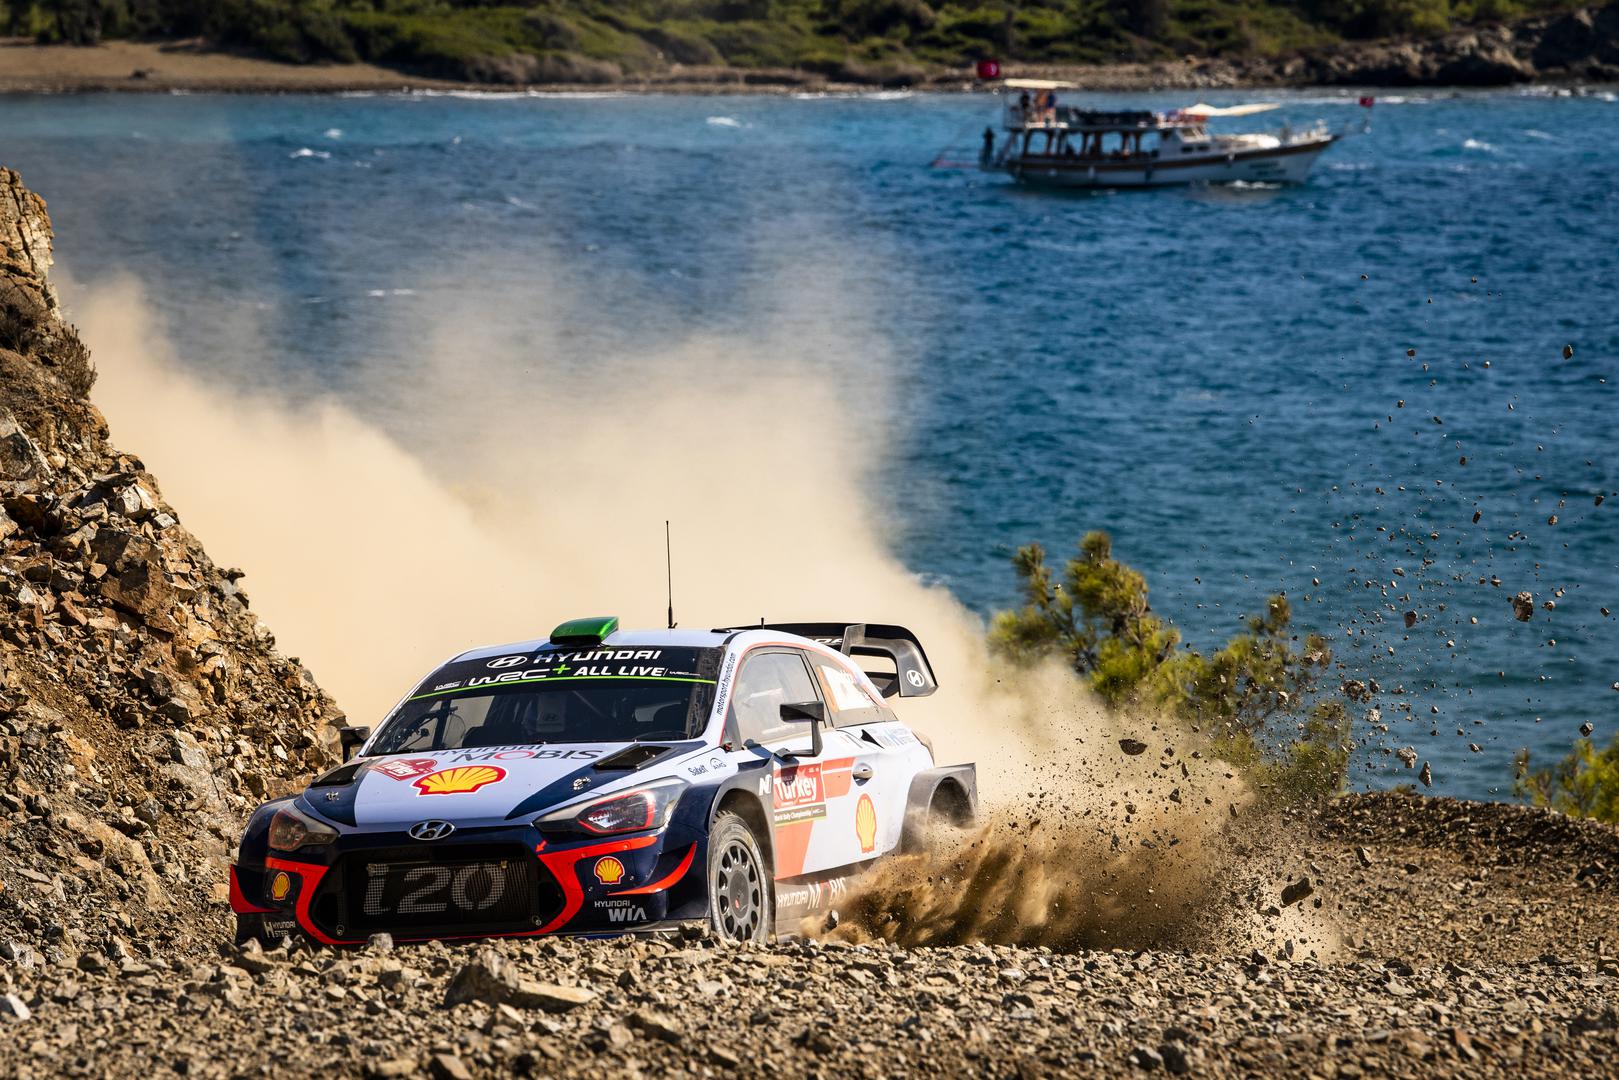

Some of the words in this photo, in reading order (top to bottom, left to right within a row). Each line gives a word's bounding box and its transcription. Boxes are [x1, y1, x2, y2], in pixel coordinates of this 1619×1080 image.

[533, 650, 662, 665] HYUNDAI
[573, 666, 612, 676] ALL
[618, 666, 665, 677] LIVE
[449, 749, 603, 763] MOBIS
[774, 775, 817, 802] Turkey
[363, 862, 506, 915] i20
[594, 900, 631, 908] HYUNDAI
[776, 890, 809, 908] HYUNDAI
[272, 920, 296, 929] HYUNDAI
